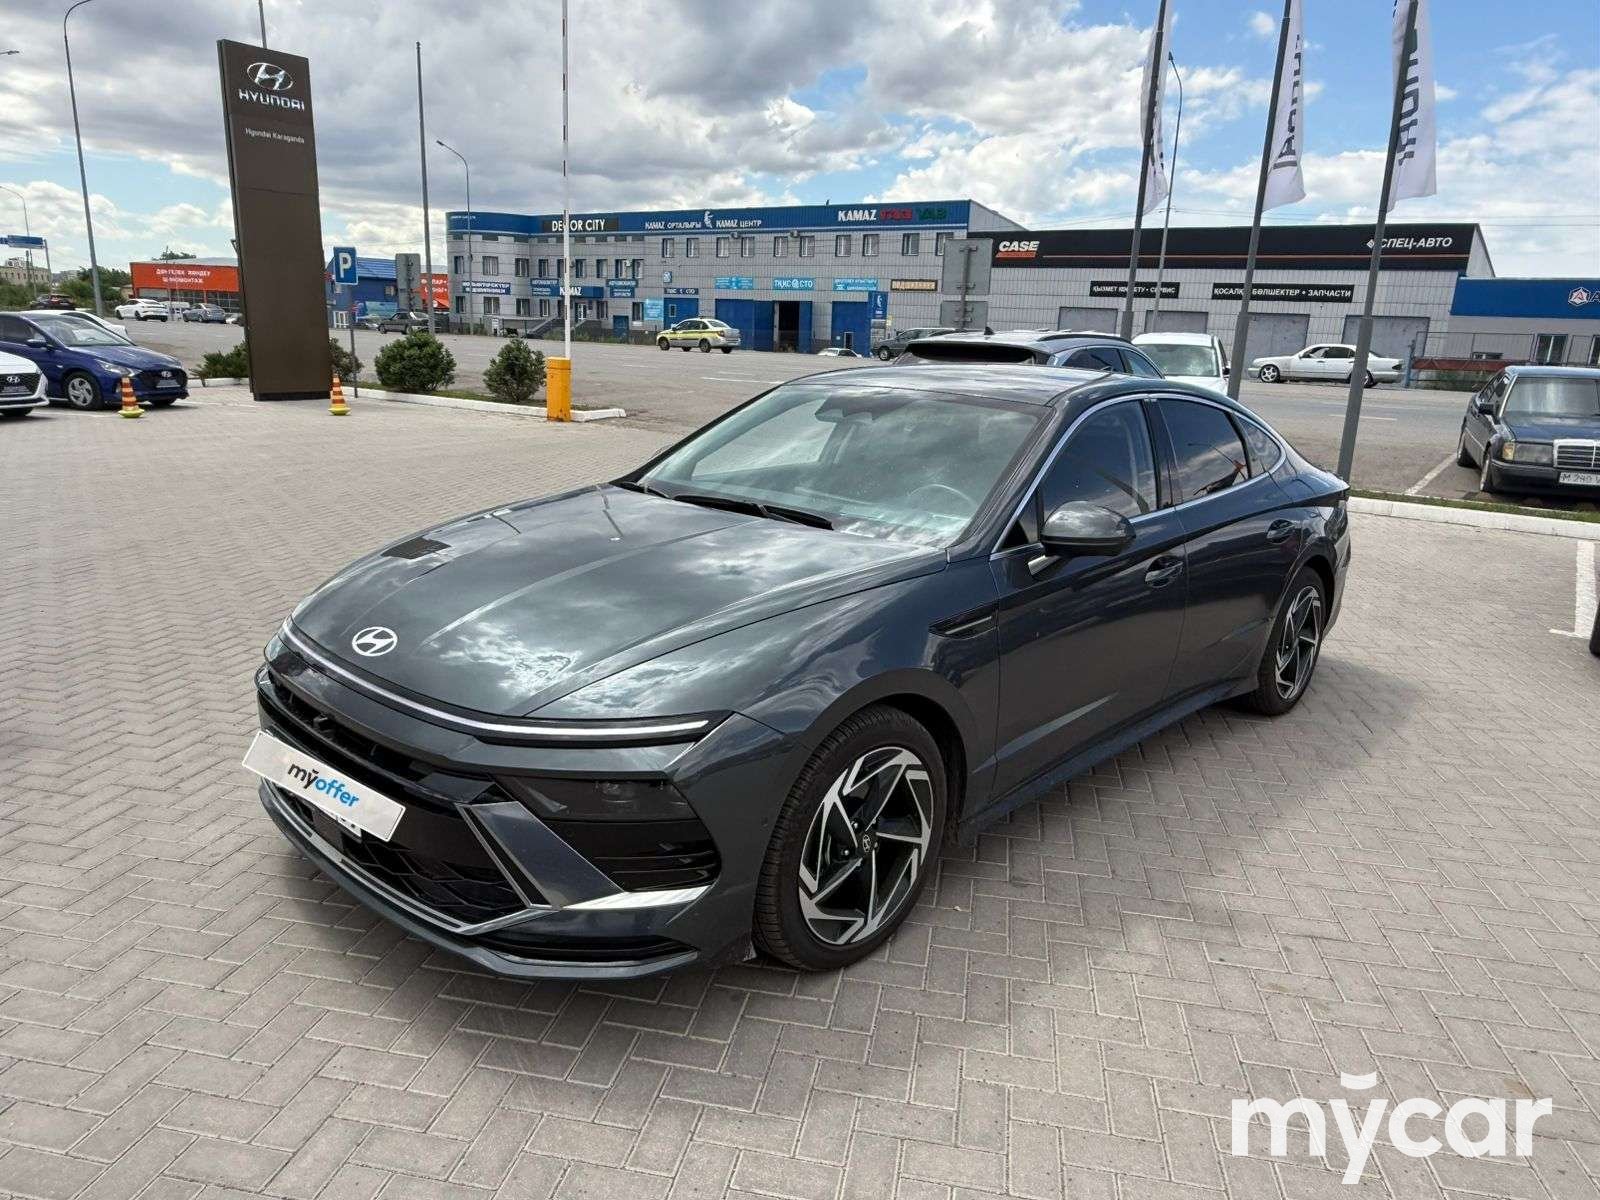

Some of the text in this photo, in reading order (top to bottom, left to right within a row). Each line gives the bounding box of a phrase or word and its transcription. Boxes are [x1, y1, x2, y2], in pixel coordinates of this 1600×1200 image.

[238, 88, 305, 111] HYUNDAI
[838, 209, 877, 221] KAMAZ
[551, 219, 605, 231] DEOR CITY
[740, 219, 762, 228] ЦЕНТР
[998, 240, 1040, 252] CASE
[1381, 237, 1453, 249] СПЕЦ-АВТО
[338, 252, 352, 279] P
[1307, 289, 1351, 297] ЗАПЧАСТИ
